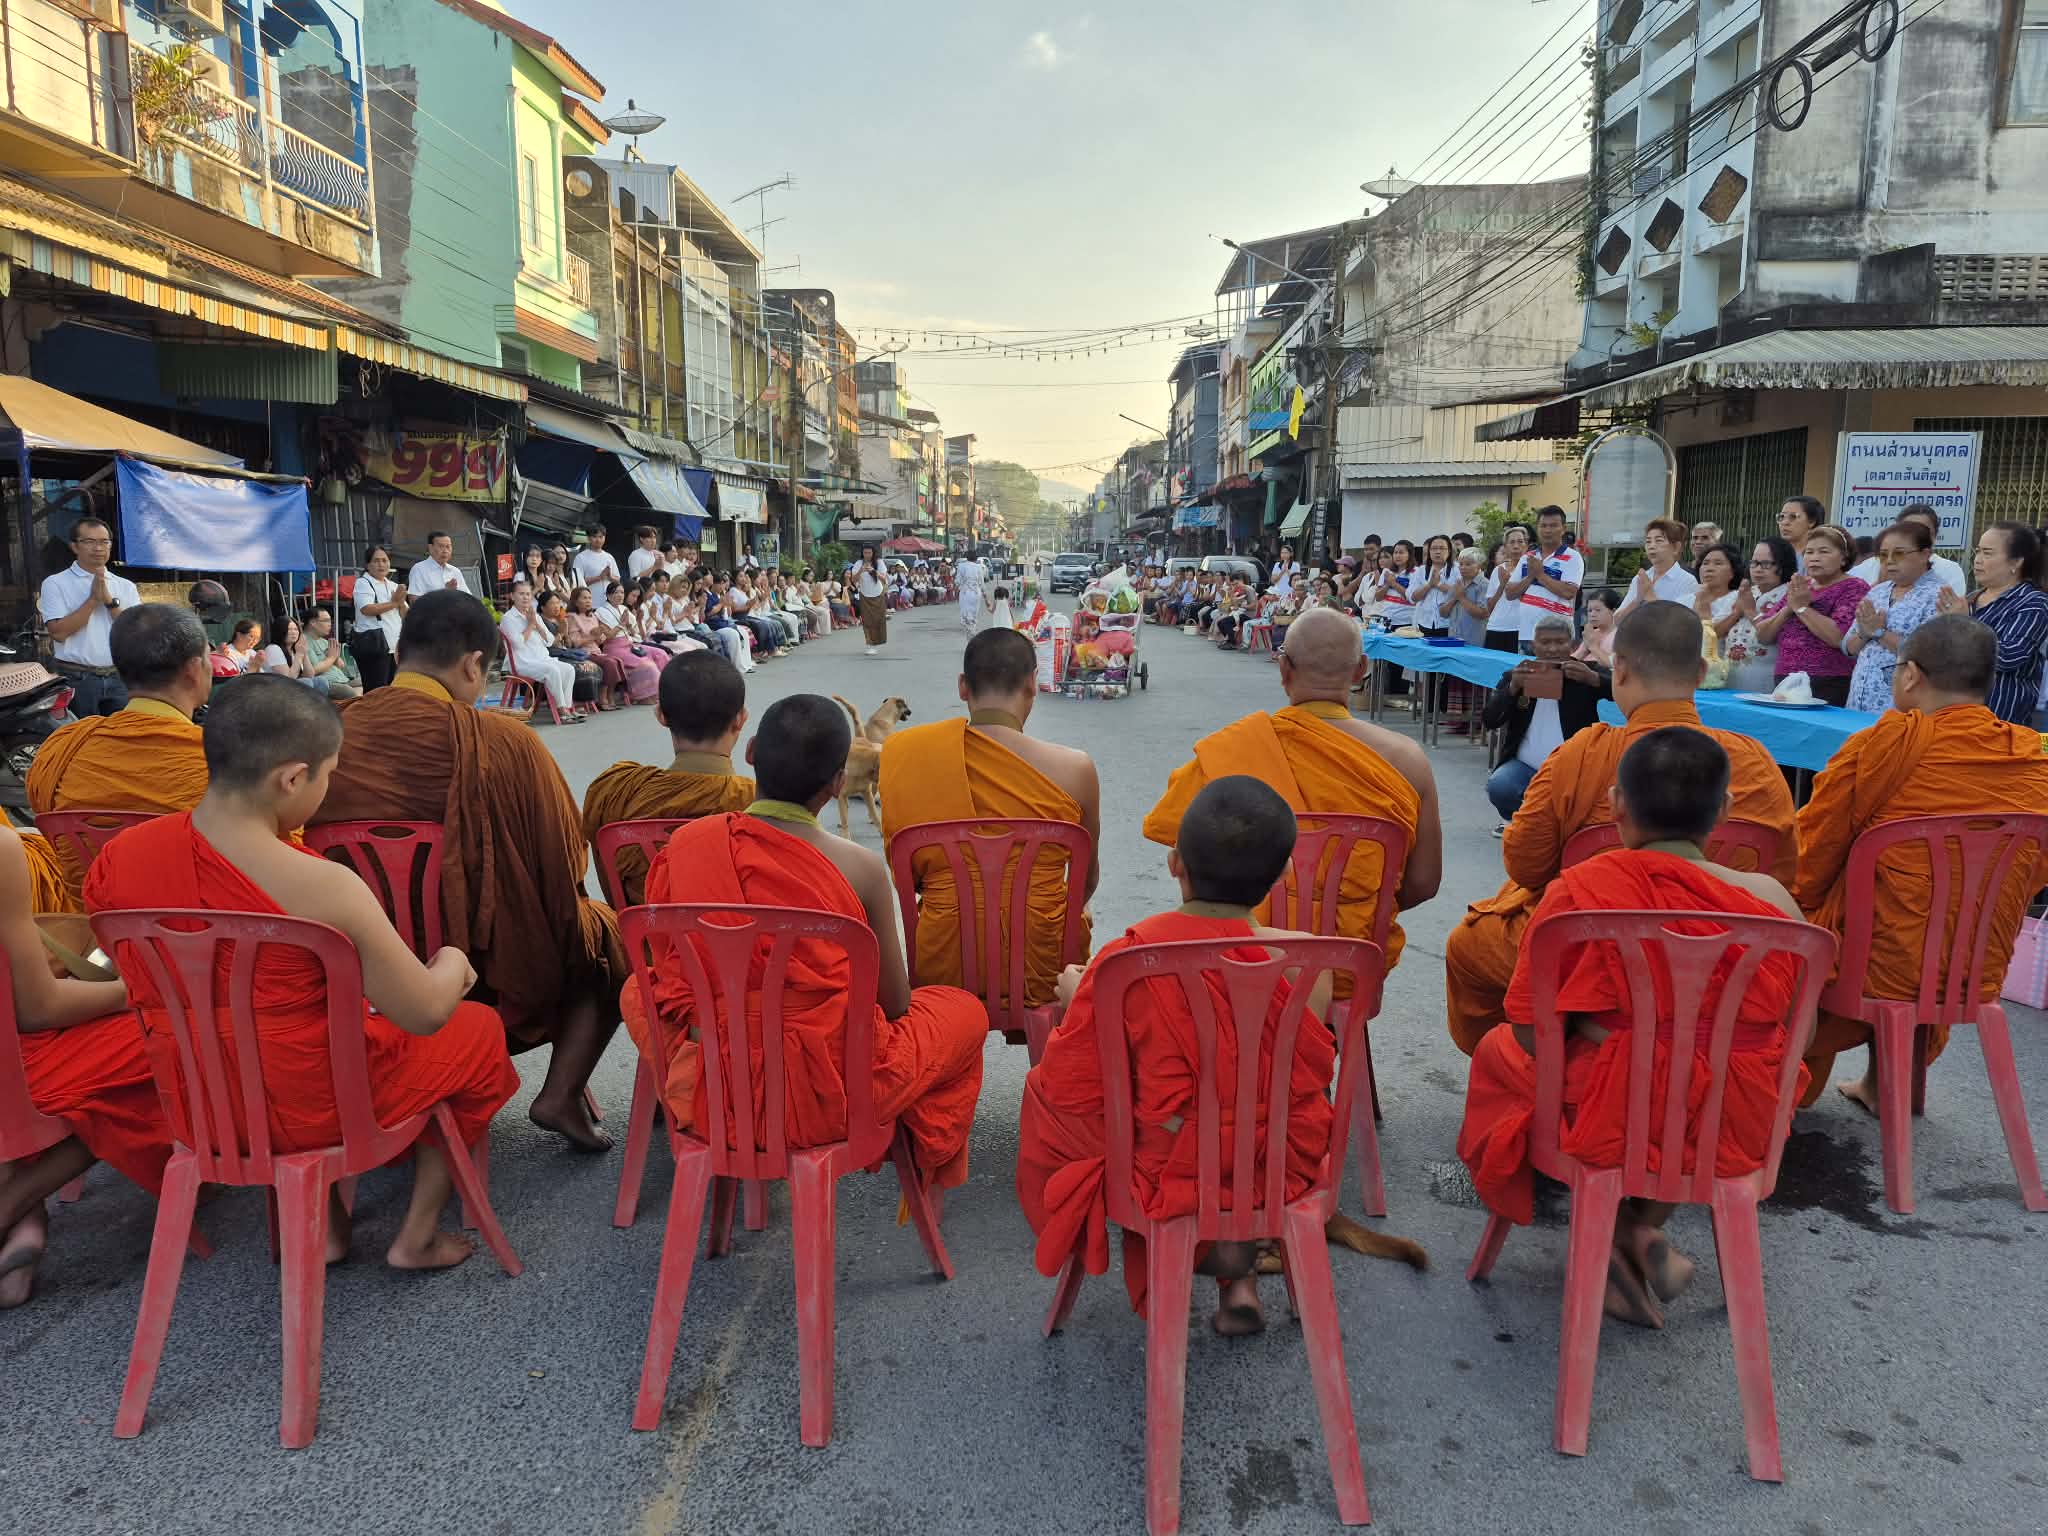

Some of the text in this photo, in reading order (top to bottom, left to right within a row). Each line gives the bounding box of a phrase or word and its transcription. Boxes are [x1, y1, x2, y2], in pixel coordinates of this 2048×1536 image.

[1851, 440, 1968, 464] ถนนส่วนบุคคล
